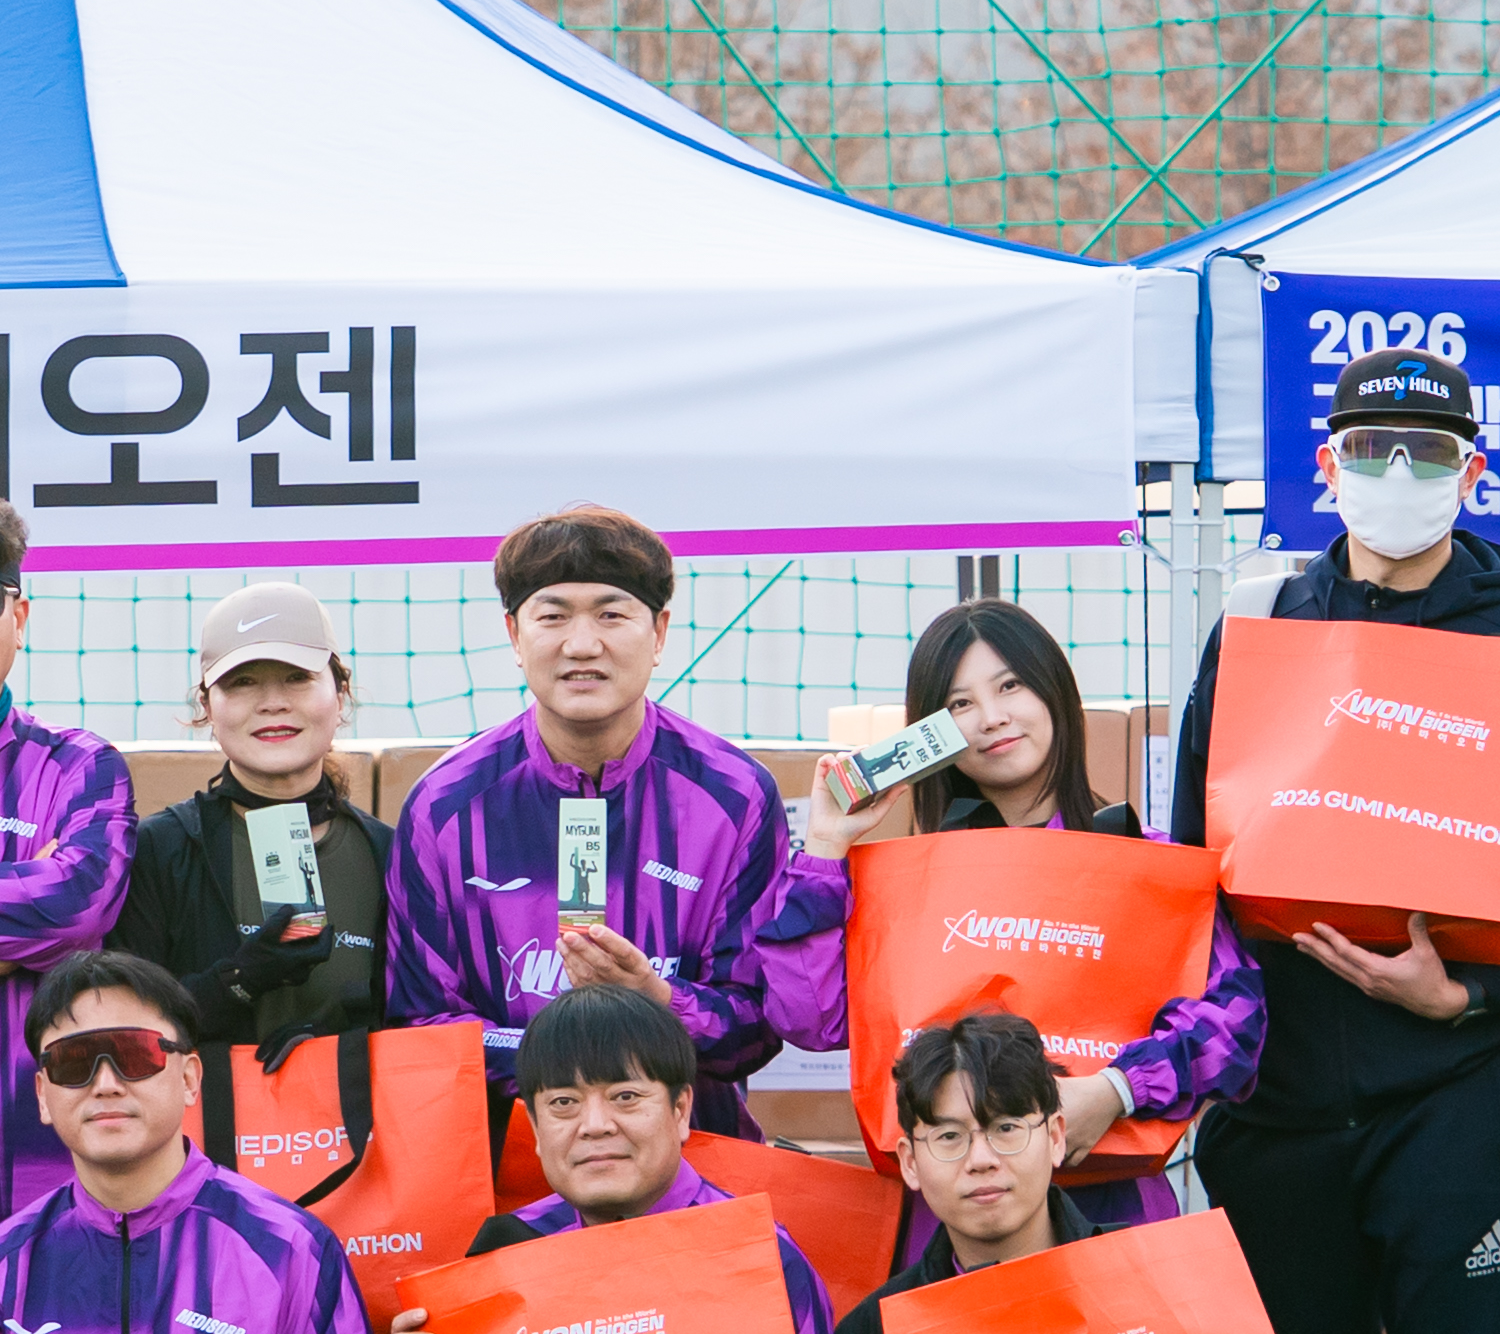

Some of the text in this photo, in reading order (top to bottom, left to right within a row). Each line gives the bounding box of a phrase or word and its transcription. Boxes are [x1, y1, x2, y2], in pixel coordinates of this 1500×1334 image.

[1309, 309, 1467, 365] 2026
[1358, 375, 1451, 400] SEVEN HILLS
[1349, 695, 1490, 743] WON BIOGEN
[1270, 789, 1321, 807] 2026
[1324, 790, 1384, 818] GUMI
[586, 842, 600, 852] B5
[967, 916, 1105, 953] WON BIOGEN
[346, 1232, 422, 1254] ATHON
